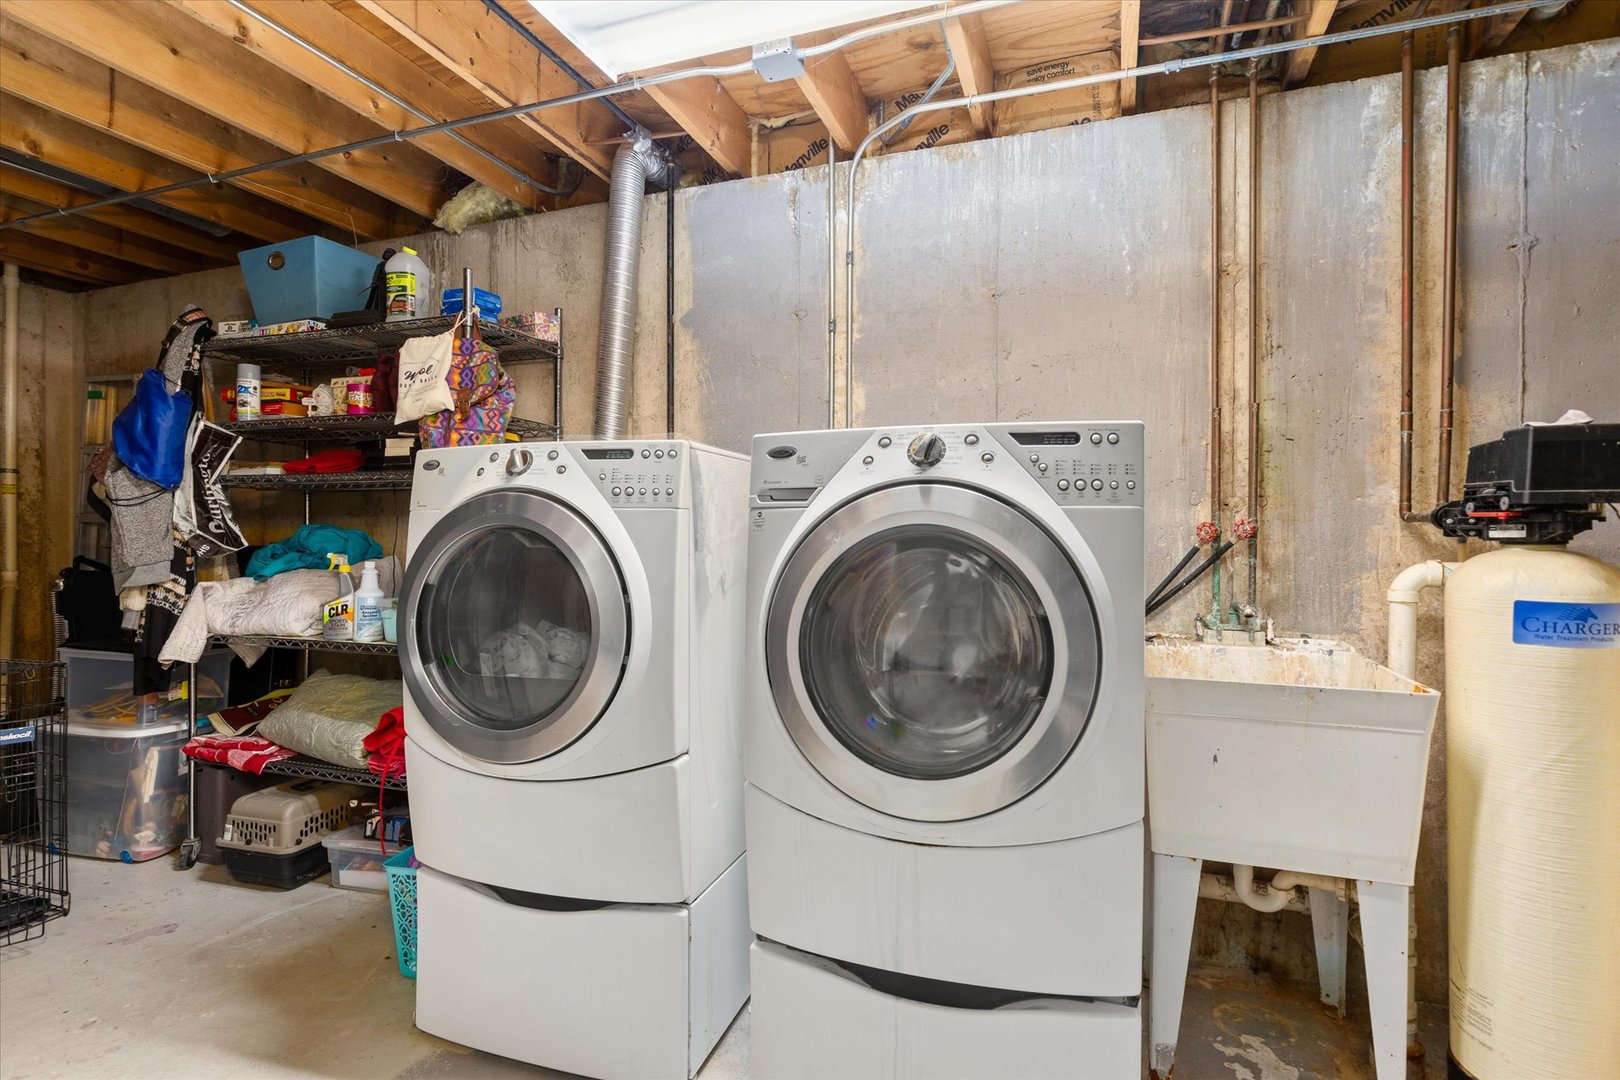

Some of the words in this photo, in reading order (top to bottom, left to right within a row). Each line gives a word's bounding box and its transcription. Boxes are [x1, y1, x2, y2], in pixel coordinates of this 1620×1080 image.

[1026, 67, 1043, 77] save
[1044, 61, 1070, 71] energy
[1027, 74, 1046, 83] enjoy
[1046, 67, 1075, 79] comfort
[328, 603, 349, 618] CLR
[1521, 616, 1620, 636] CHARGER
[0, 730, 32, 741] oskocil
